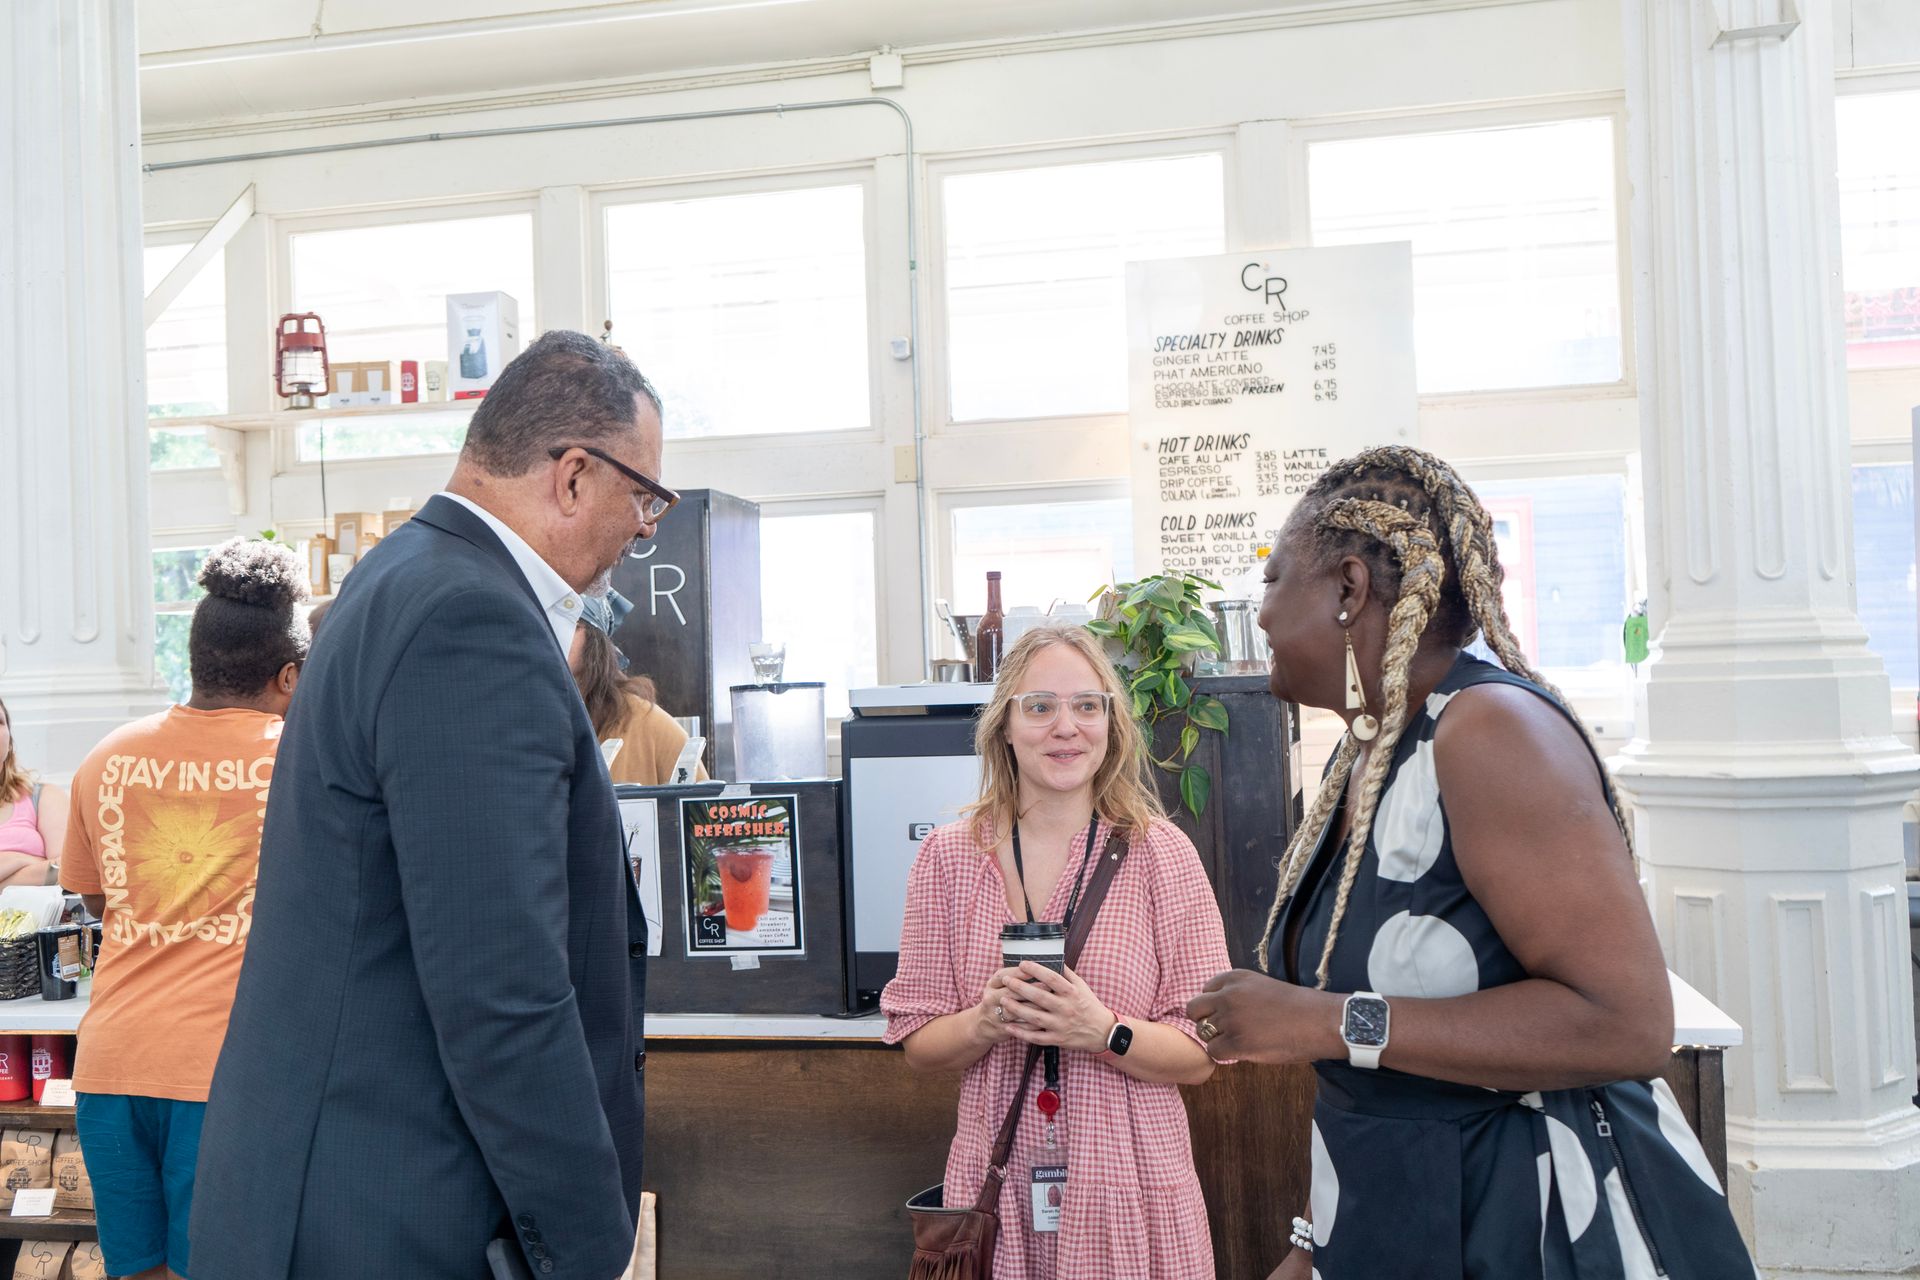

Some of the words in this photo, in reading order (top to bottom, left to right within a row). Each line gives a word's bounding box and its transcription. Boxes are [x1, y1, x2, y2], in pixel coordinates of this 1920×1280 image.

[1224, 313, 1266, 326] COFFEE
[1273, 310, 1310, 324] SHOP
[1154, 332, 1227, 352] SPECIALTY
[1234, 327, 1285, 348] DRINKS
[1152, 353, 1200, 367] GINGER
[1207, 350, 1249, 363] LATTE
[1154, 368, 1185, 380] PHAT
[1190, 362, 1263, 378] AMERICANO
[1314, 358, 1336, 371] 6.45
[1154, 388, 1209, 400] ESPRESSO
[1212, 386, 1240, 397] BEAN
[1241, 383, 1285, 395] FROZEN
[1314, 379, 1337, 391] 6.75
[1155, 399, 1180, 408] COLD
[1158, 436, 1191, 454] HOT
[1194, 433, 1251, 452] DRINKS
[1159, 455, 1190, 466] CAFE
[1196, 454, 1210, 464] AU
[1215, 452, 1242, 463] LAIT
[1283, 448, 1327, 460] LATTE
[1159, 464, 1222, 478] ESPRESSO
[1284, 460, 1331, 471] VANILLA
[1160, 478, 1185, 490] DRIP
[1187, 475, 1232, 488] COFFEE
[1284, 473, 1319, 483] MOCH
[1160, 489, 1197, 502] COLADA
[1284, 485, 1307, 496] CAP
[1160, 515, 1196, 532] COLD
[1204, 511, 1257, 530] DRINKS
[1161, 532, 1205, 544] SWEET
[1211, 530, 1257, 541] VANILLA
[1264, 529, 1279, 540] CR
[1161, 545, 1207, 556] MOCHA
[1212, 543, 1244, 554] COLD
[1162, 557, 1196, 568] COLD
[1201, 556, 1231, 566] BREW
[1162, 568, 1213, 579] FROZEN
[1221, 566, 1252, 577] COF
[102, 754, 174, 790] STAY
[178, 761, 210, 792] IN
[708, 804, 769, 820] COSMIC
[97, 784, 128, 887] SPACE
[694, 822, 785, 838] REFRESHER
[703, 918, 720, 938] CR
[16, 1127, 42, 1157] CR
[31, 1240, 53, 1275] CR
